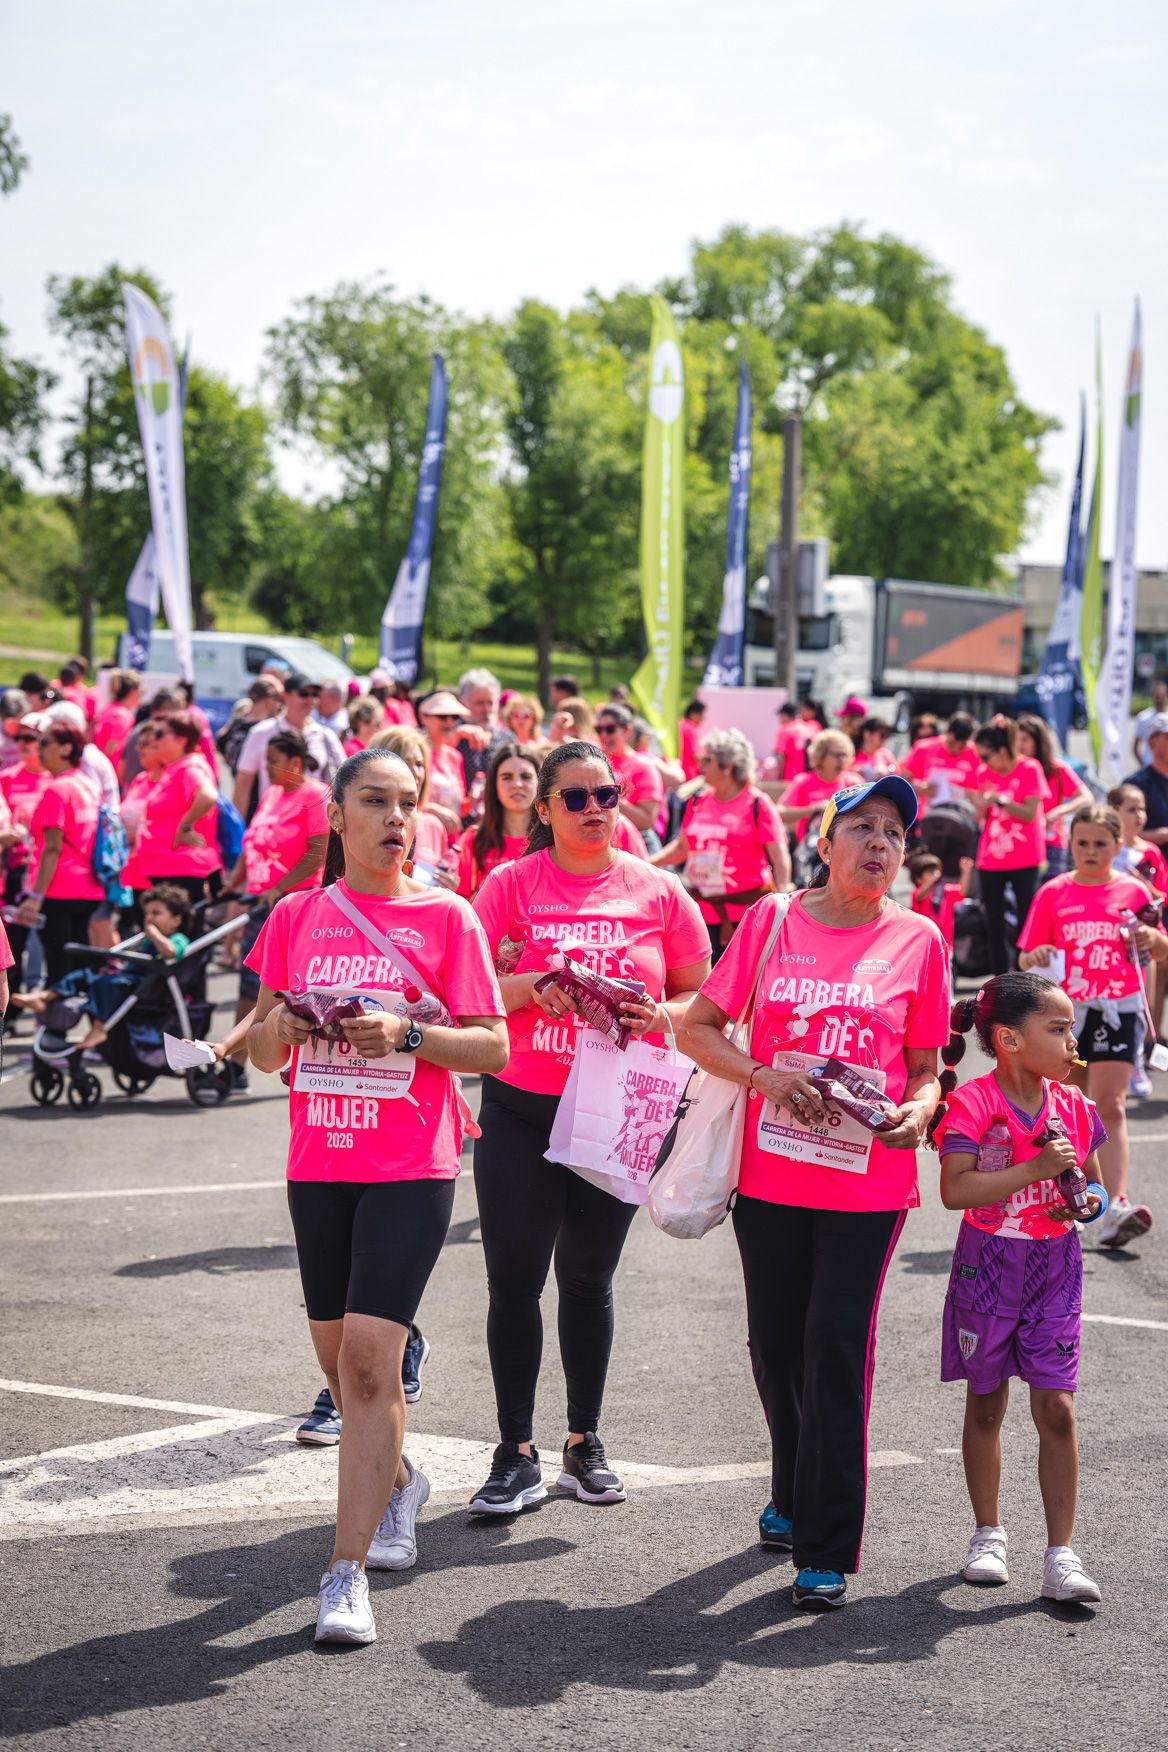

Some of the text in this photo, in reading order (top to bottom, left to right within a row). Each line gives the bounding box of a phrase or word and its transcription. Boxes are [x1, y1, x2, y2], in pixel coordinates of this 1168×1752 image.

[528, 904, 568, 914] OYSHO
[311, 927, 353, 939] OYSHO
[532, 921, 627, 944] CARRERA
[1088, 945, 1113, 970] DE
[305, 955, 403, 984] CARRERA
[769, 977, 875, 1009] CARRERA
[532, 1025, 582, 1056] MUJ
[818, 1015, 858, 1057] DE
[586, 1040, 619, 1054] OYSHO
[348, 1059, 367, 1067] 1453
[363, 1069, 408, 1079] VITORIA-GASTEIZ
[309, 1078, 344, 1088] OYSHO
[364, 1083, 398, 1092] Santander
[626, 1069, 677, 1098] CARRERA
[307, 1097, 379, 1129] MUJER
[644, 1101, 664, 1122] DE
[762, 1123, 787, 1135] CARRERA
[802, 1133, 820, 1143] MUJER
[824, 1138, 865, 1153] VITORIA-GASTEIZ
[809, 1125, 829, 1136] 1448
[326, 1132, 354, 1149] 2026
[634, 1135, 650, 1153] LA
[768, 1138, 803, 1153] OYSHO
[824, 1153, 855, 1165] Santander
